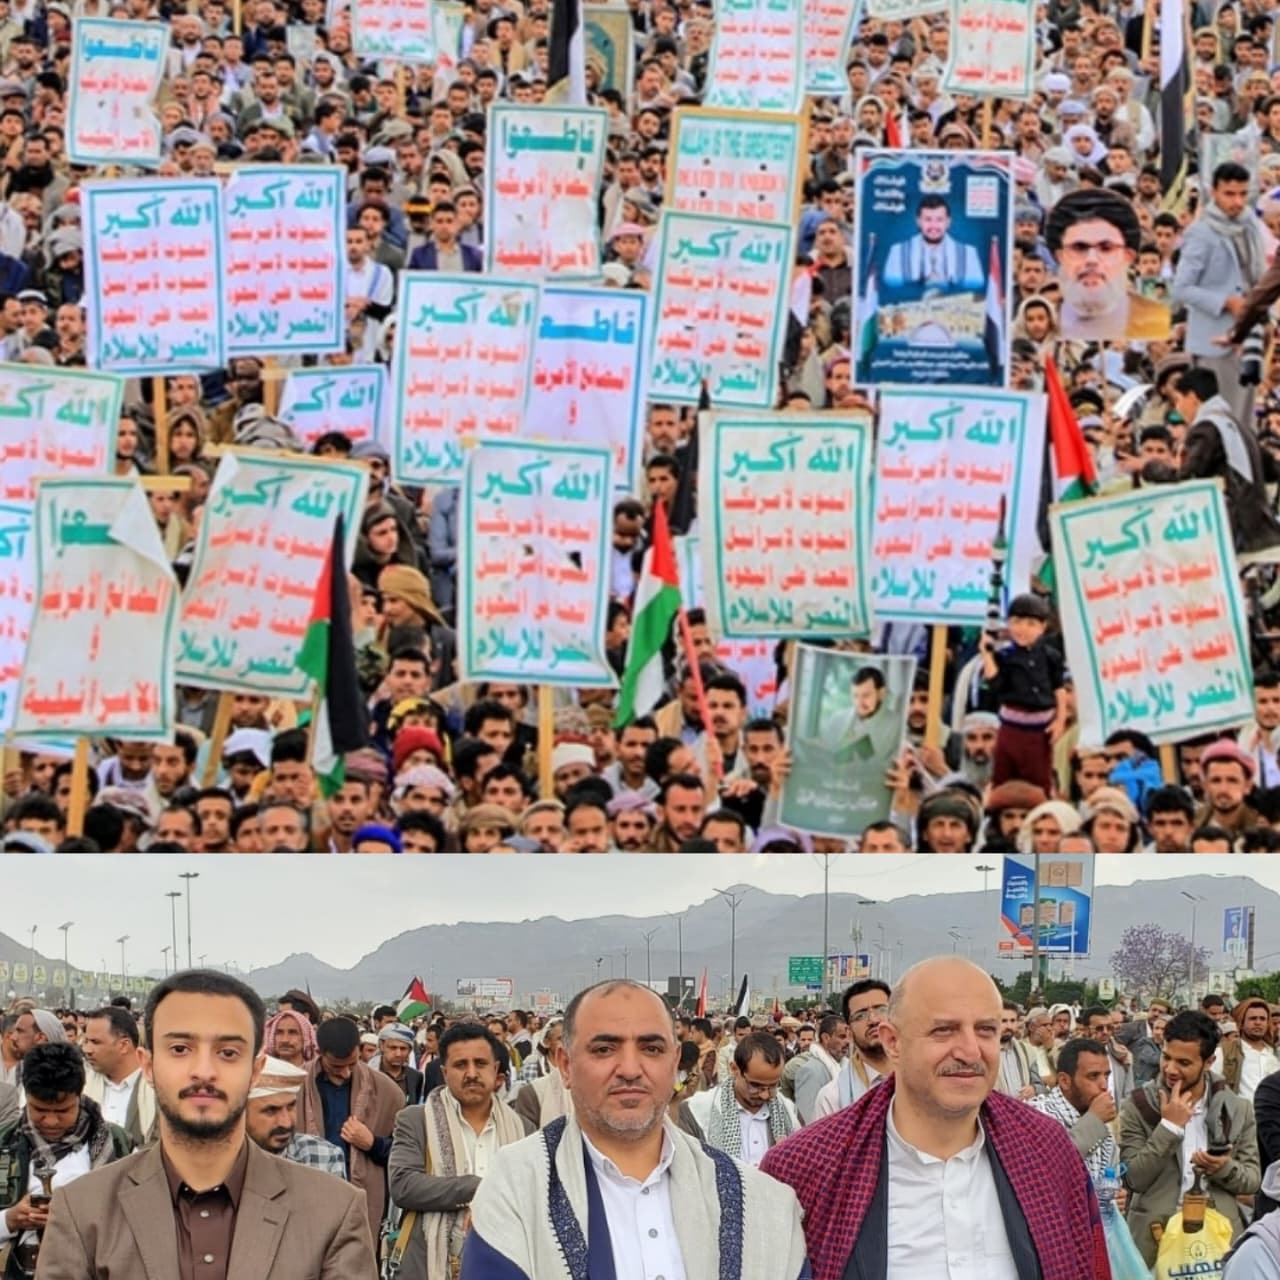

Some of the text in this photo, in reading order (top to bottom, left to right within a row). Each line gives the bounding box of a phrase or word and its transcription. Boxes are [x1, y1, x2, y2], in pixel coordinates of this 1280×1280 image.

[539, 310, 635, 344] قاطع
[724, 431, 853, 482] الله أكبر
[1080, 503, 1213, 570] الله أكبر
